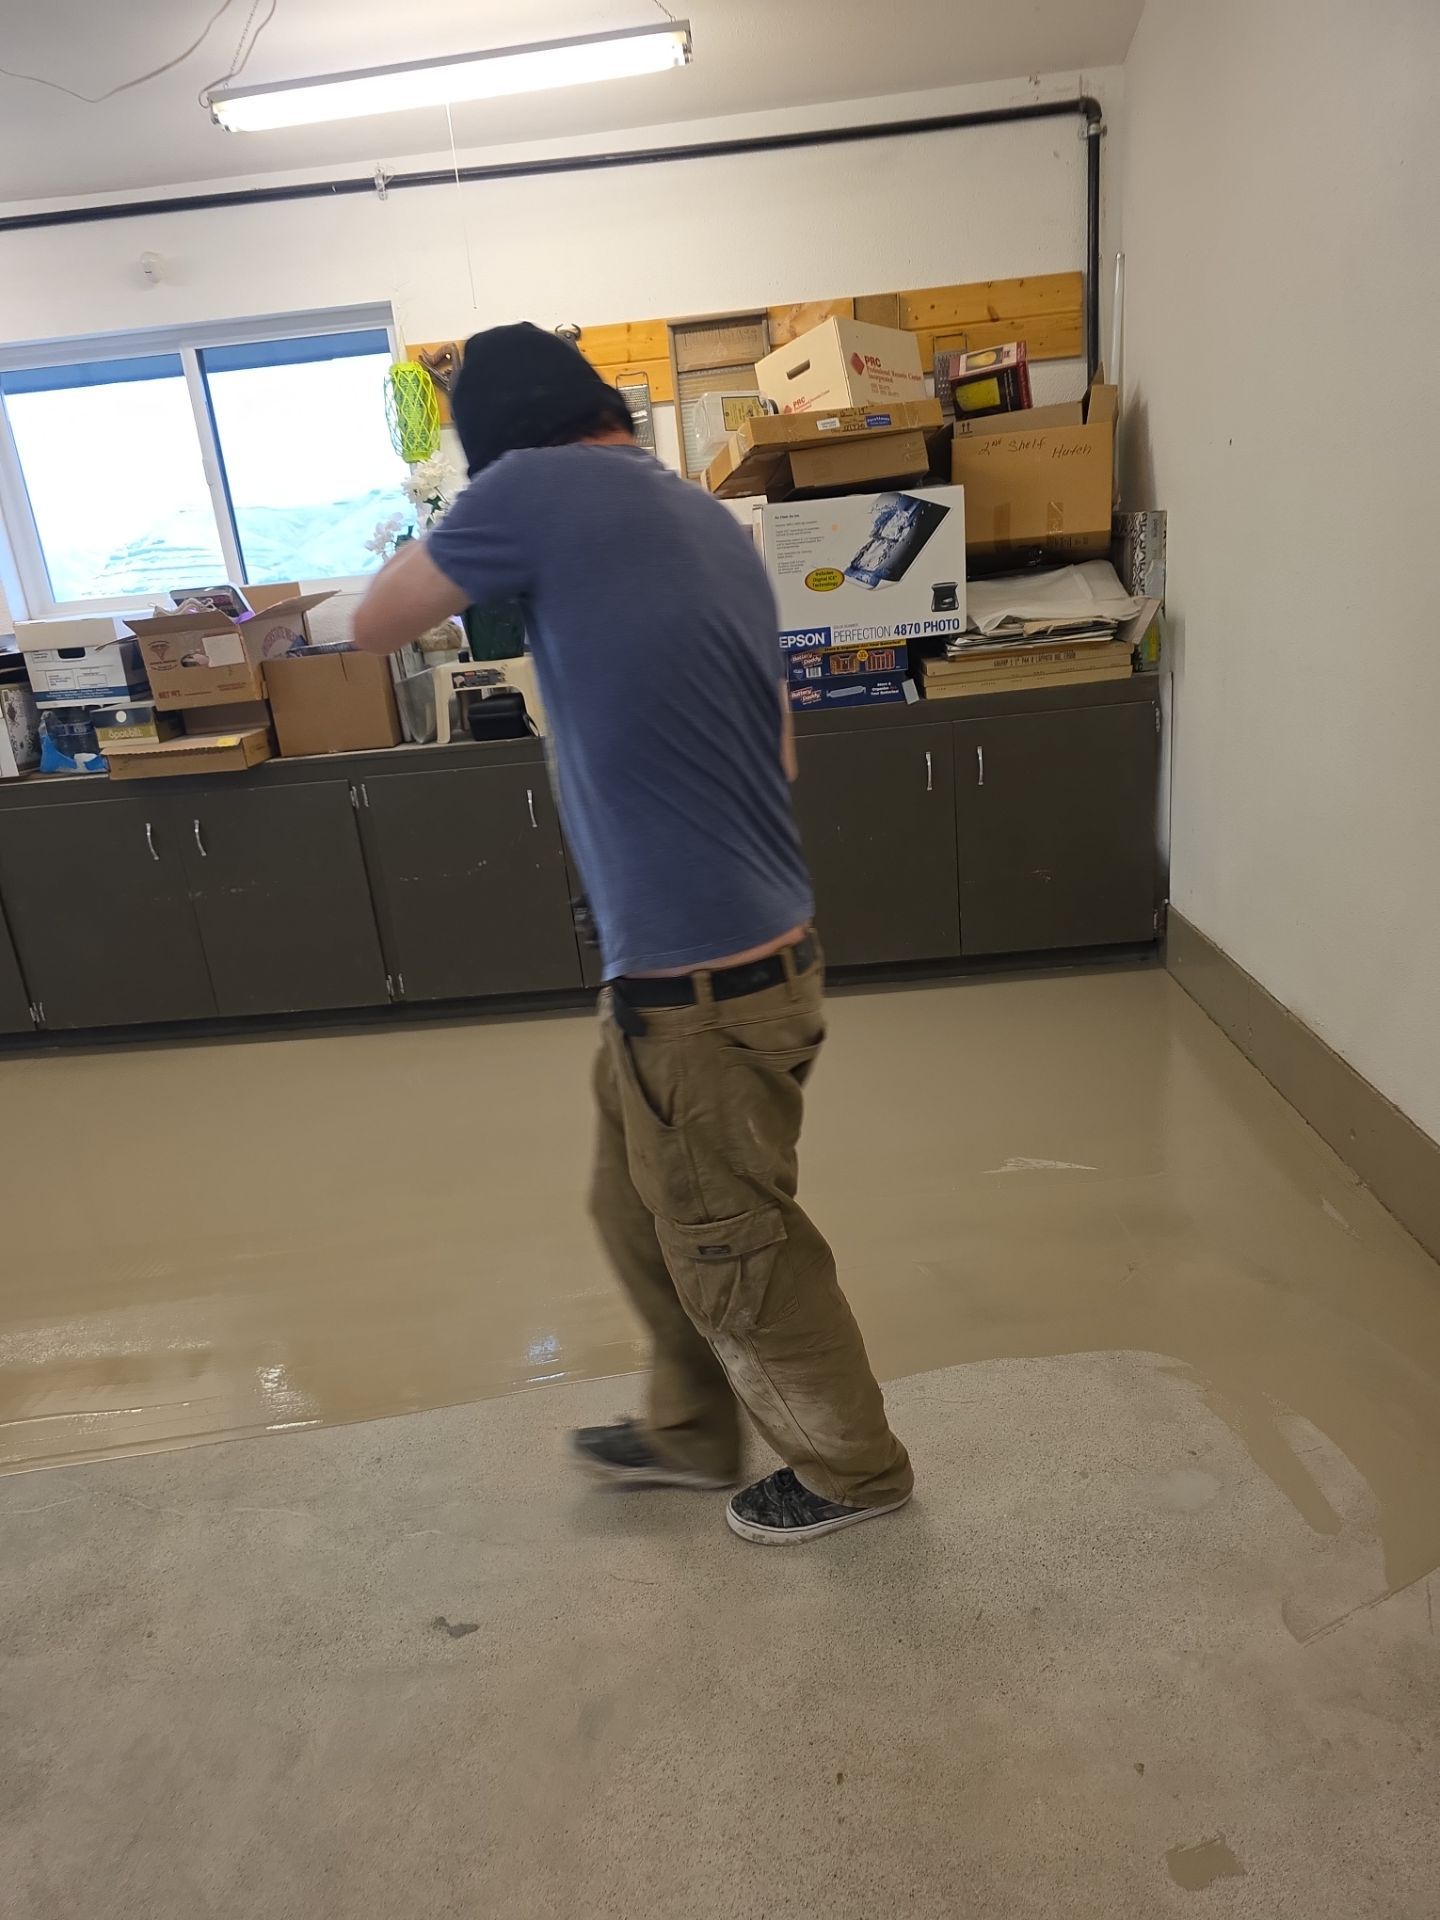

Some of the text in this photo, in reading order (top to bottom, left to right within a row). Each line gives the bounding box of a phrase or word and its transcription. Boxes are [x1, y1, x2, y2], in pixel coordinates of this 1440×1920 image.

[864, 355, 881, 368] PRC
[1008, 436, 1046, 452] Shelf
[834, 617, 960, 643] PERFECTION 4870 PHOTO
[779, 632, 826, 649] EPSON
[791, 652, 813, 662] Battery
[803, 655, 822, 666] Daddy
[791, 688, 813, 698] Battery
[802, 693, 821, 702] Daddy
